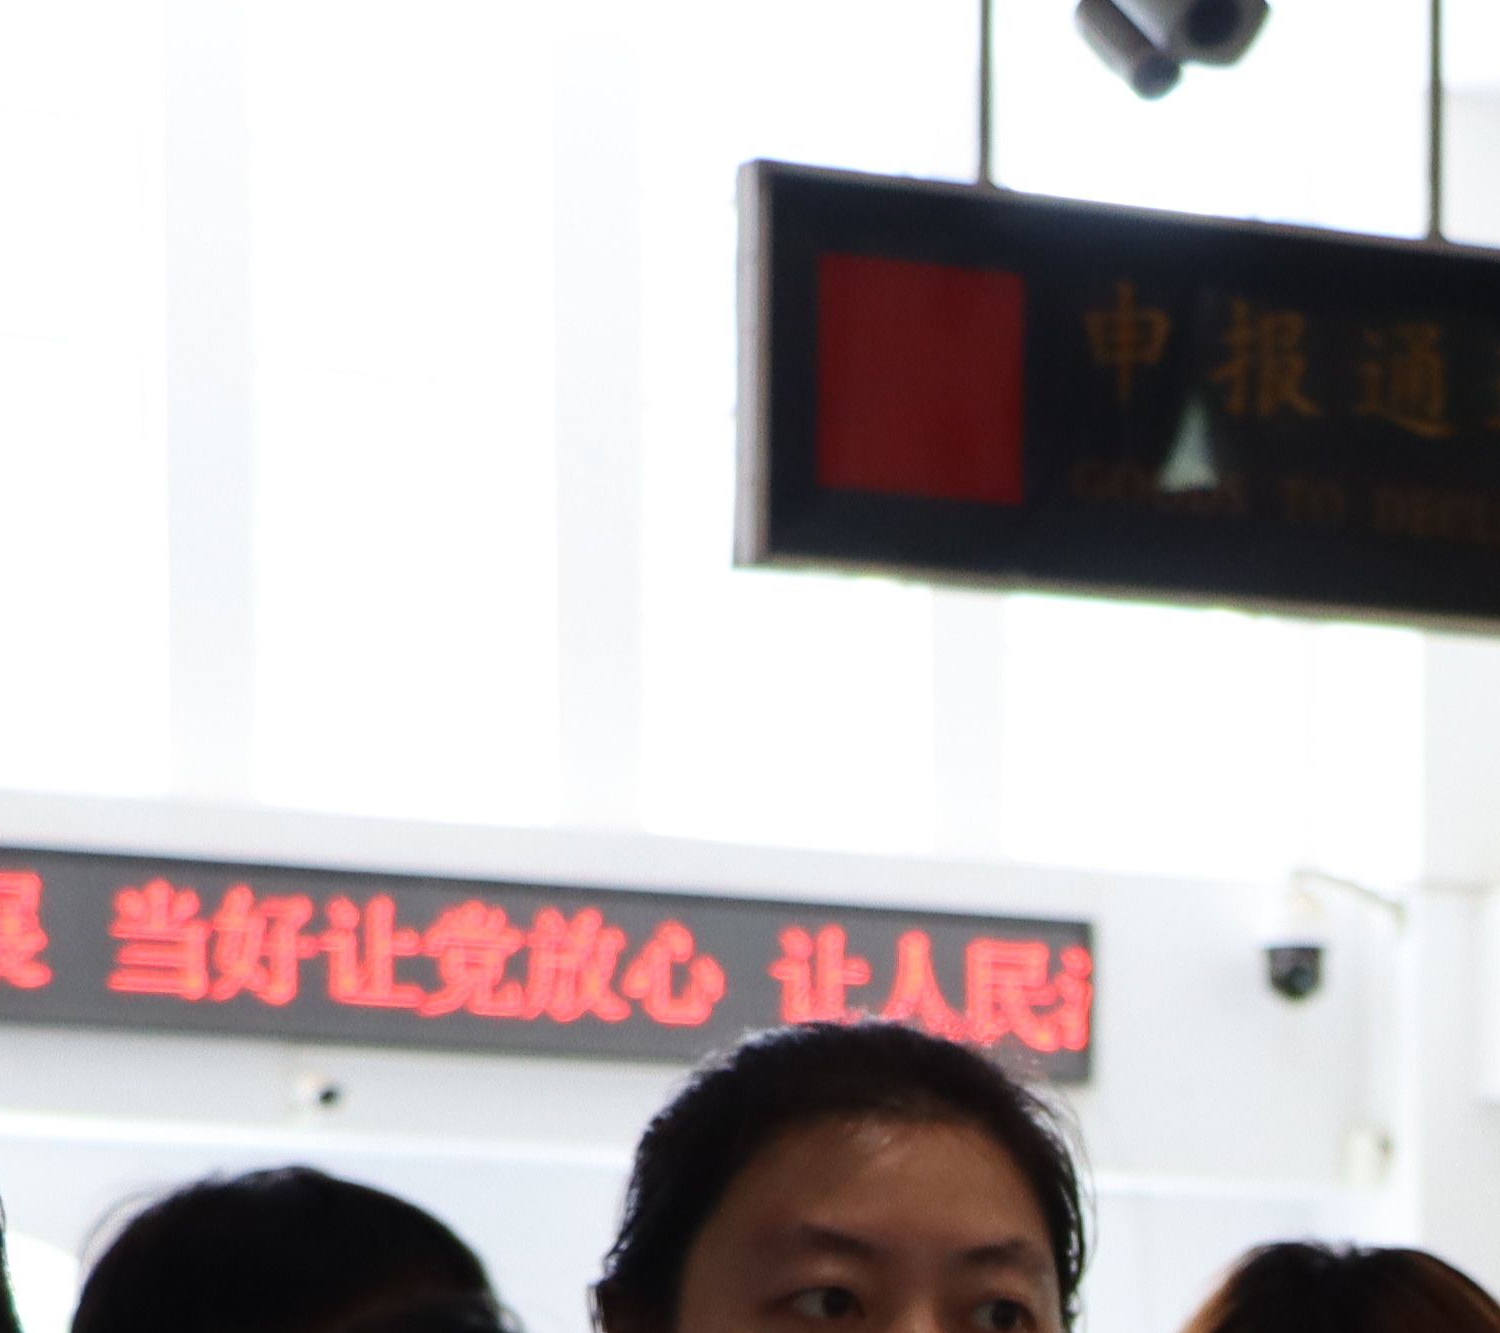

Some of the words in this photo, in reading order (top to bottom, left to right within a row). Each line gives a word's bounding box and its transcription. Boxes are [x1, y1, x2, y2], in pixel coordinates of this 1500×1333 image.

[106, 877, 727, 1028] 当好让党放心
